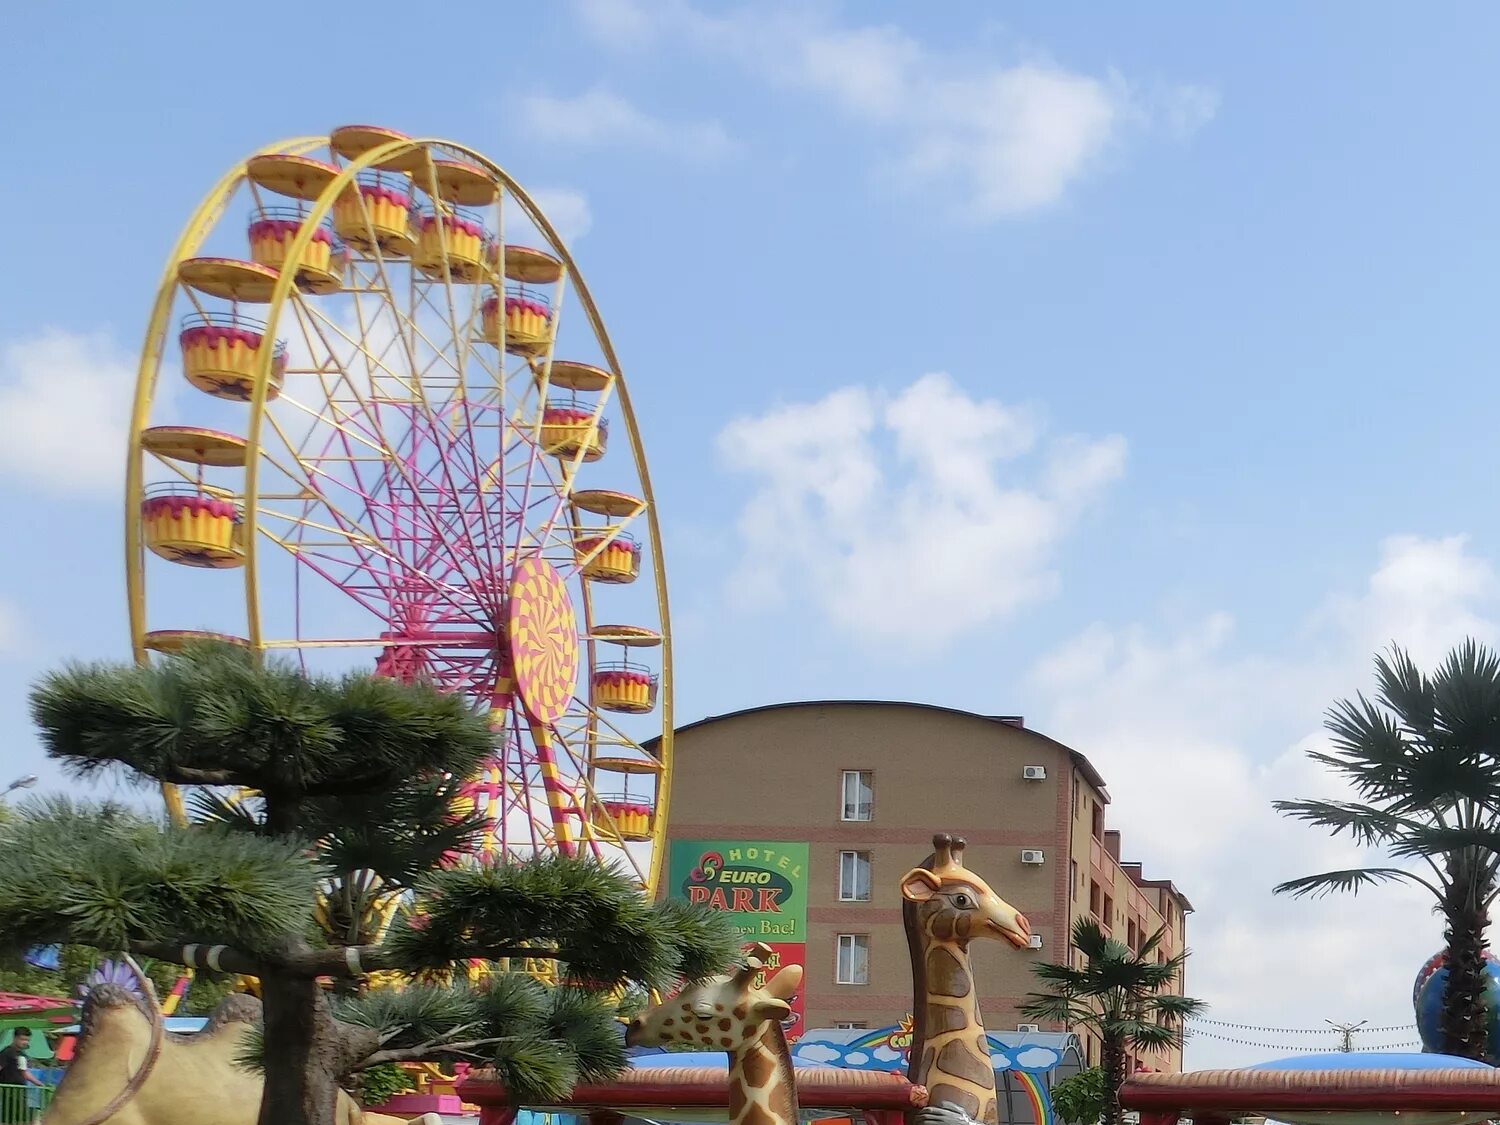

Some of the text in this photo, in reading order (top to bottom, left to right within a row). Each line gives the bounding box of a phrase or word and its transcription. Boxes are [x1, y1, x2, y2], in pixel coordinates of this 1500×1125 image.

[728, 847, 802, 879] HOTEL
[719, 870, 771, 884] EURO
[687, 885, 783, 914] PARK
[759, 919, 796, 935] Вас!
